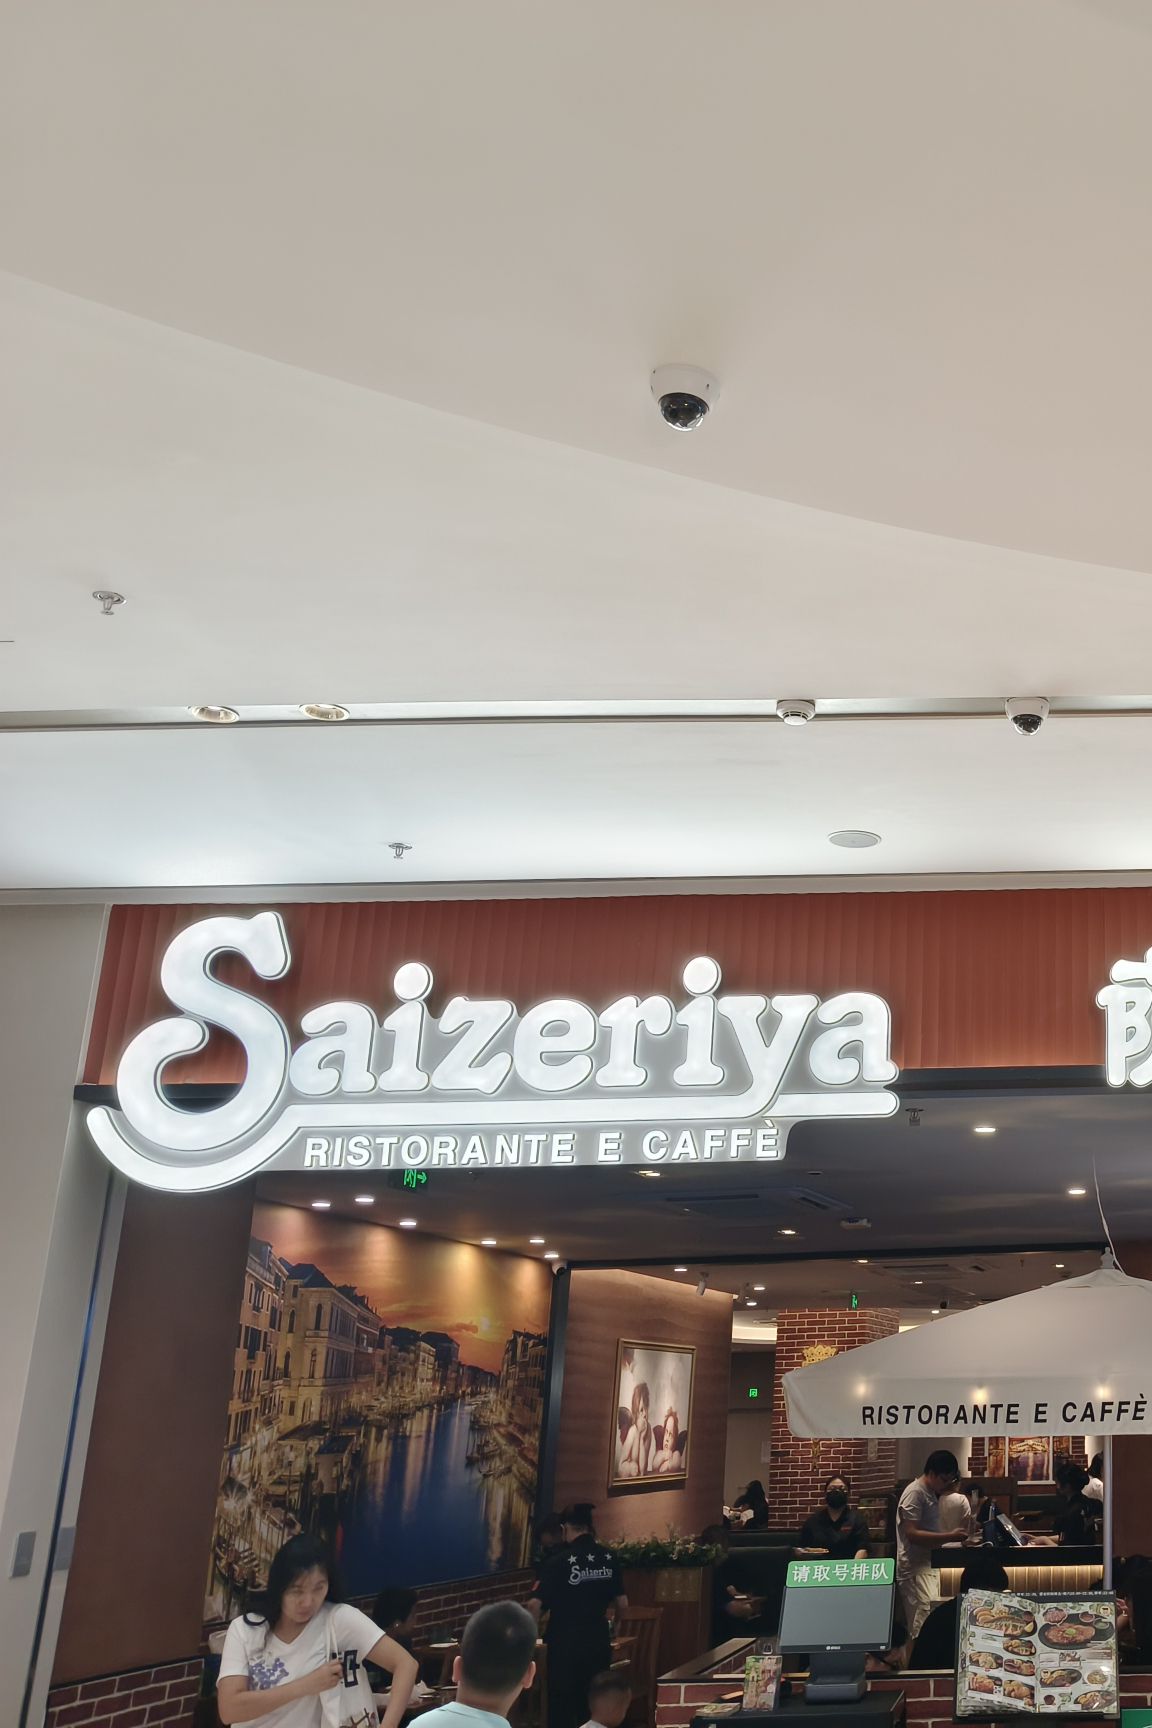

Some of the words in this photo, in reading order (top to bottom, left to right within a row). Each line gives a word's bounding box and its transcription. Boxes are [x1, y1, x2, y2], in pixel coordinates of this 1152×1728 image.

[87, 909, 901, 1192] Saizeriya
[303, 1133, 575, 1167] RISTORANTE
[598, 1132, 623, 1163] E
[642, 1119, 779, 1161] CAFFÈ
[861, 1403, 1020, 1425] RISTORANTE
[1034, 1403, 1048, 1424] E
[1062, 1393, 1148, 1423] CAFFÈ
[792, 1563, 888, 1583] 请取号排队
